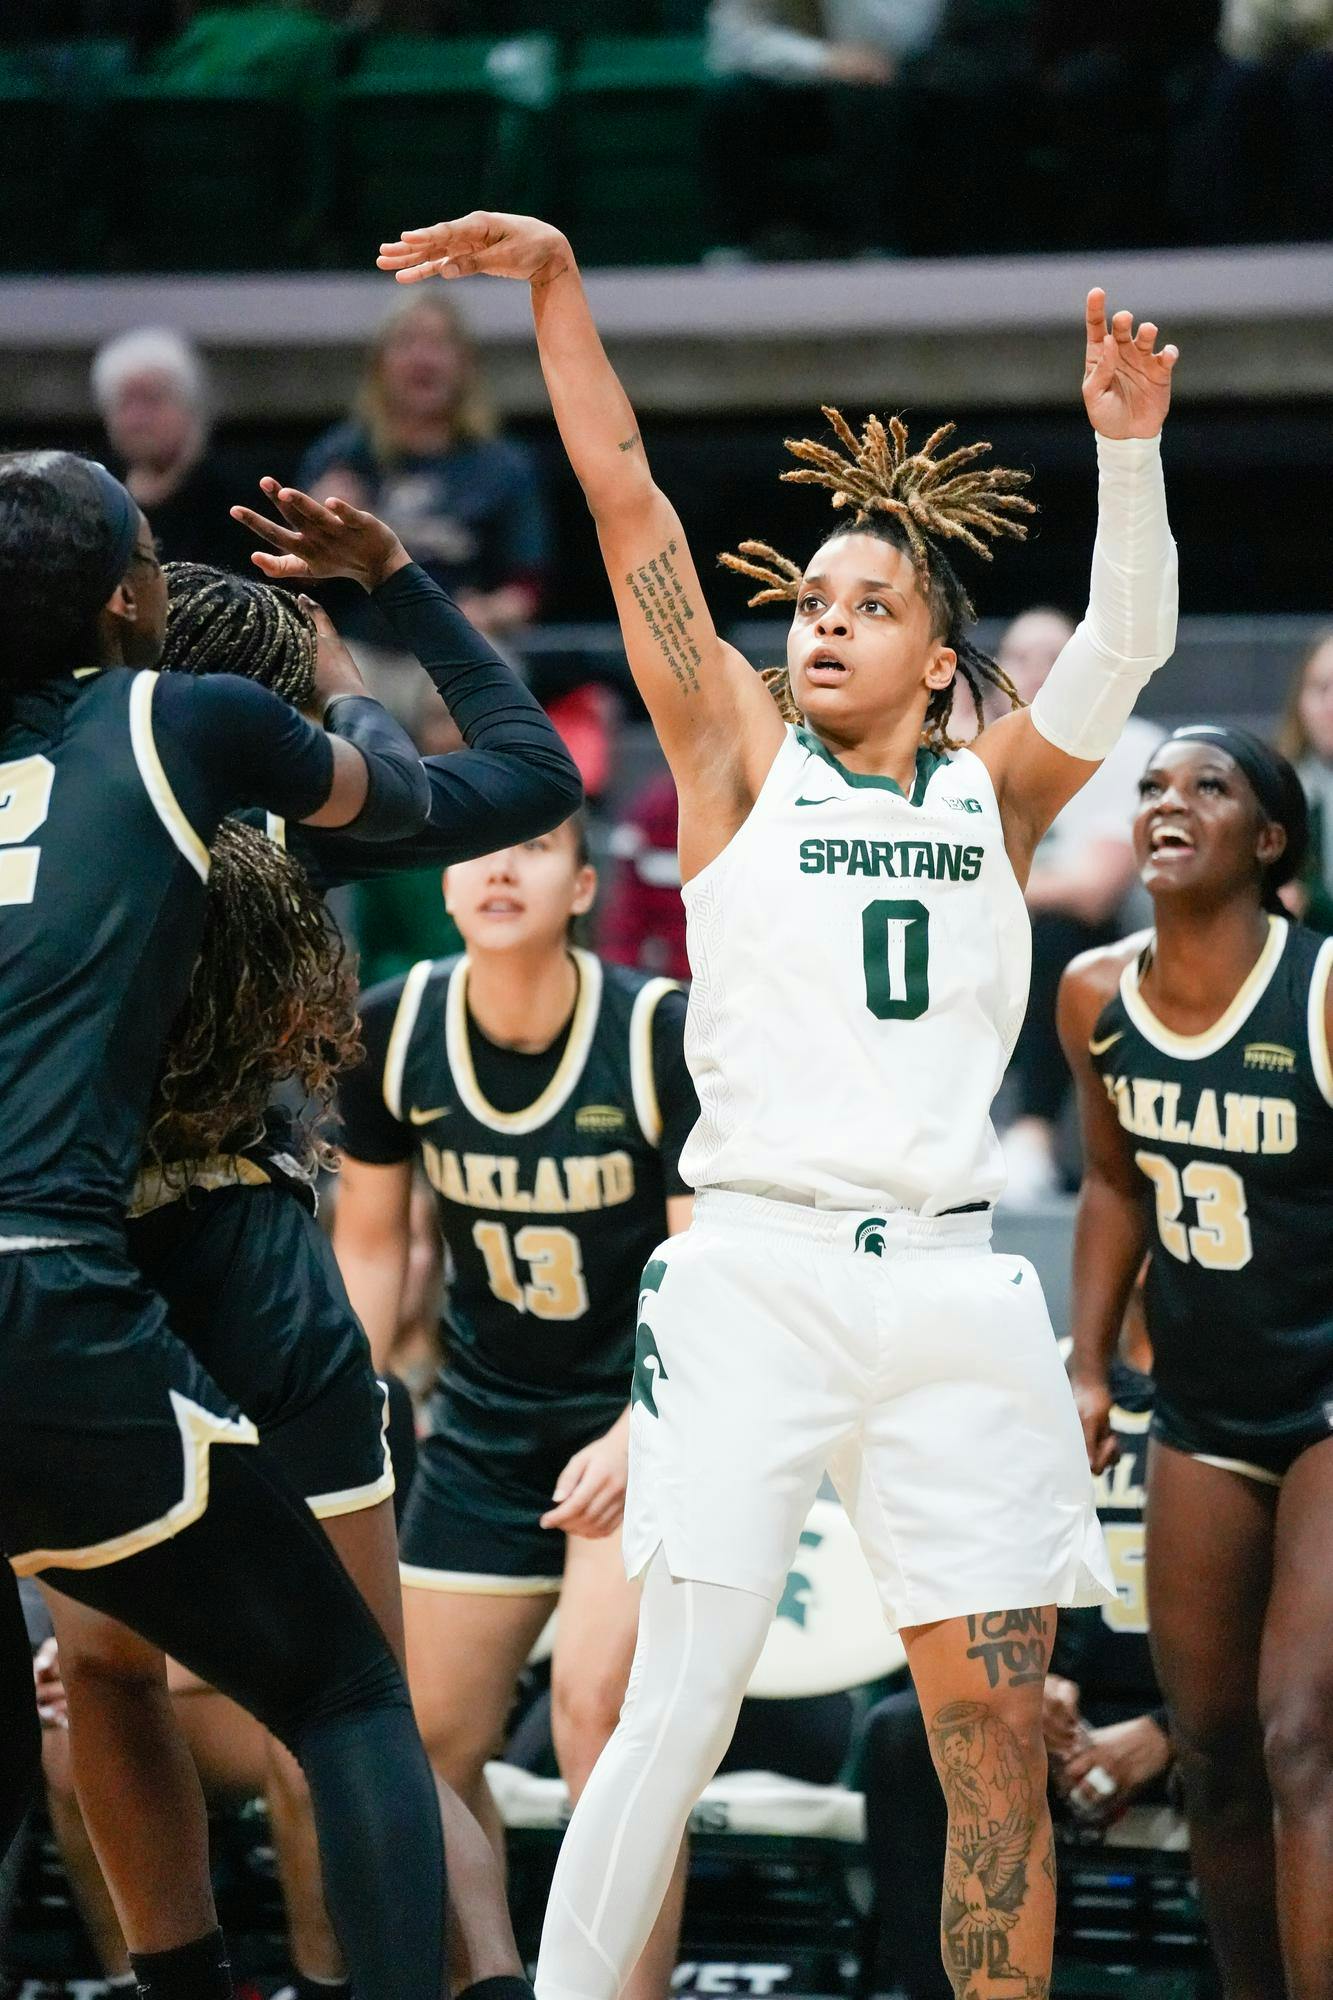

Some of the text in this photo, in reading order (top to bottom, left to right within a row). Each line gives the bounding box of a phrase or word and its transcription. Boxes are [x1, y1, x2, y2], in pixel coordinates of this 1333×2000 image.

[799, 838, 985, 881] SPARTANS
[861, 899, 930, 1020] 0
[1134, 1150, 1253, 1271] 23
[472, 1219, 590, 1321] 13
[950, 1820, 1000, 1843] CHILD
[962, 1843, 980, 1857] OF
